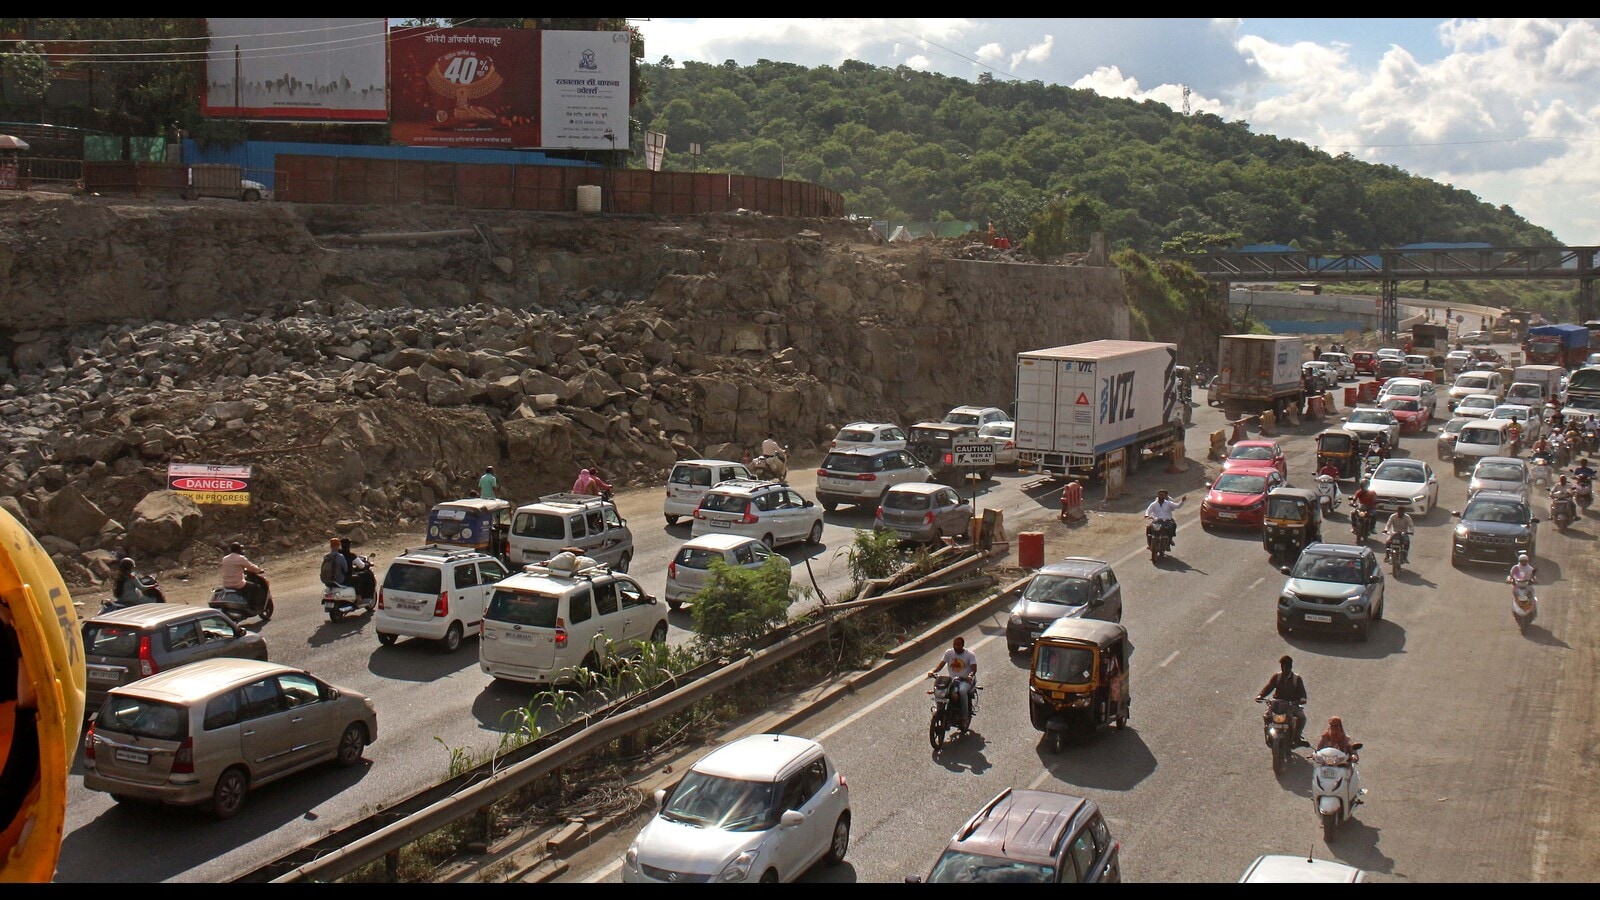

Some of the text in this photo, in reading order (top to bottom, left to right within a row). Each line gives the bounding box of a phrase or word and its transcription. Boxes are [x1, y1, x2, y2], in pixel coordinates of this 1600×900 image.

[1078, 362, 1093, 373] VTL
[1109, 370, 1135, 424] VTL
[186, 480, 233, 489] DANGER
[205, 494, 249, 502] PROGRESS
